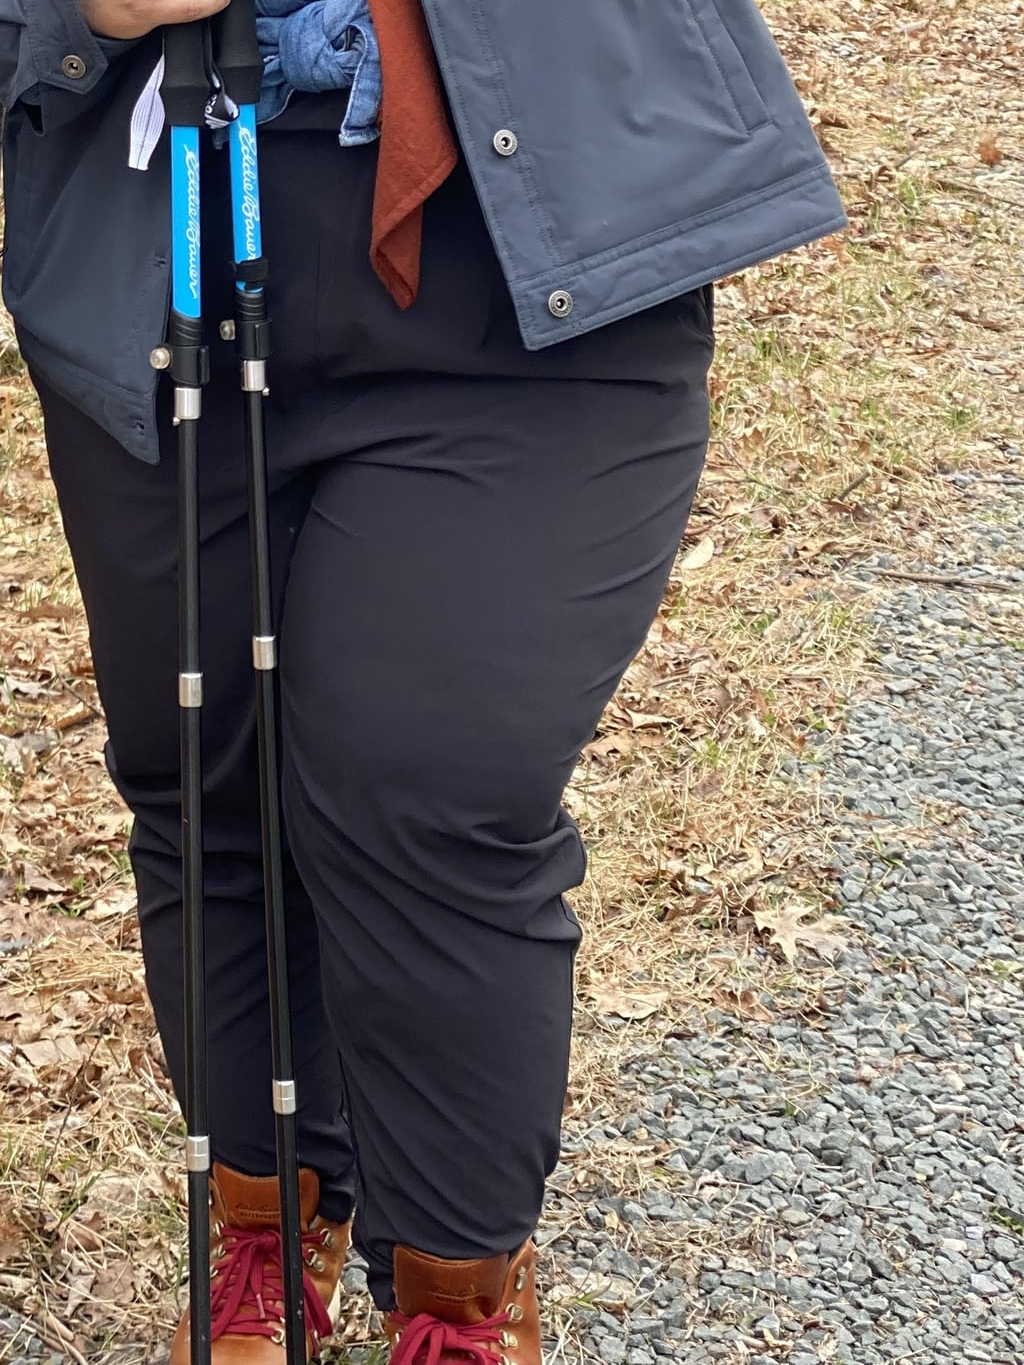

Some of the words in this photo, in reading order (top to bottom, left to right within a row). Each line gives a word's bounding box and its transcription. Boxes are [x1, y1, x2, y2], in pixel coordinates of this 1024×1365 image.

[184, 145, 200, 216] Eddie
[238, 121, 257, 193] Eddie
[186, 213, 201, 299] Bauer
